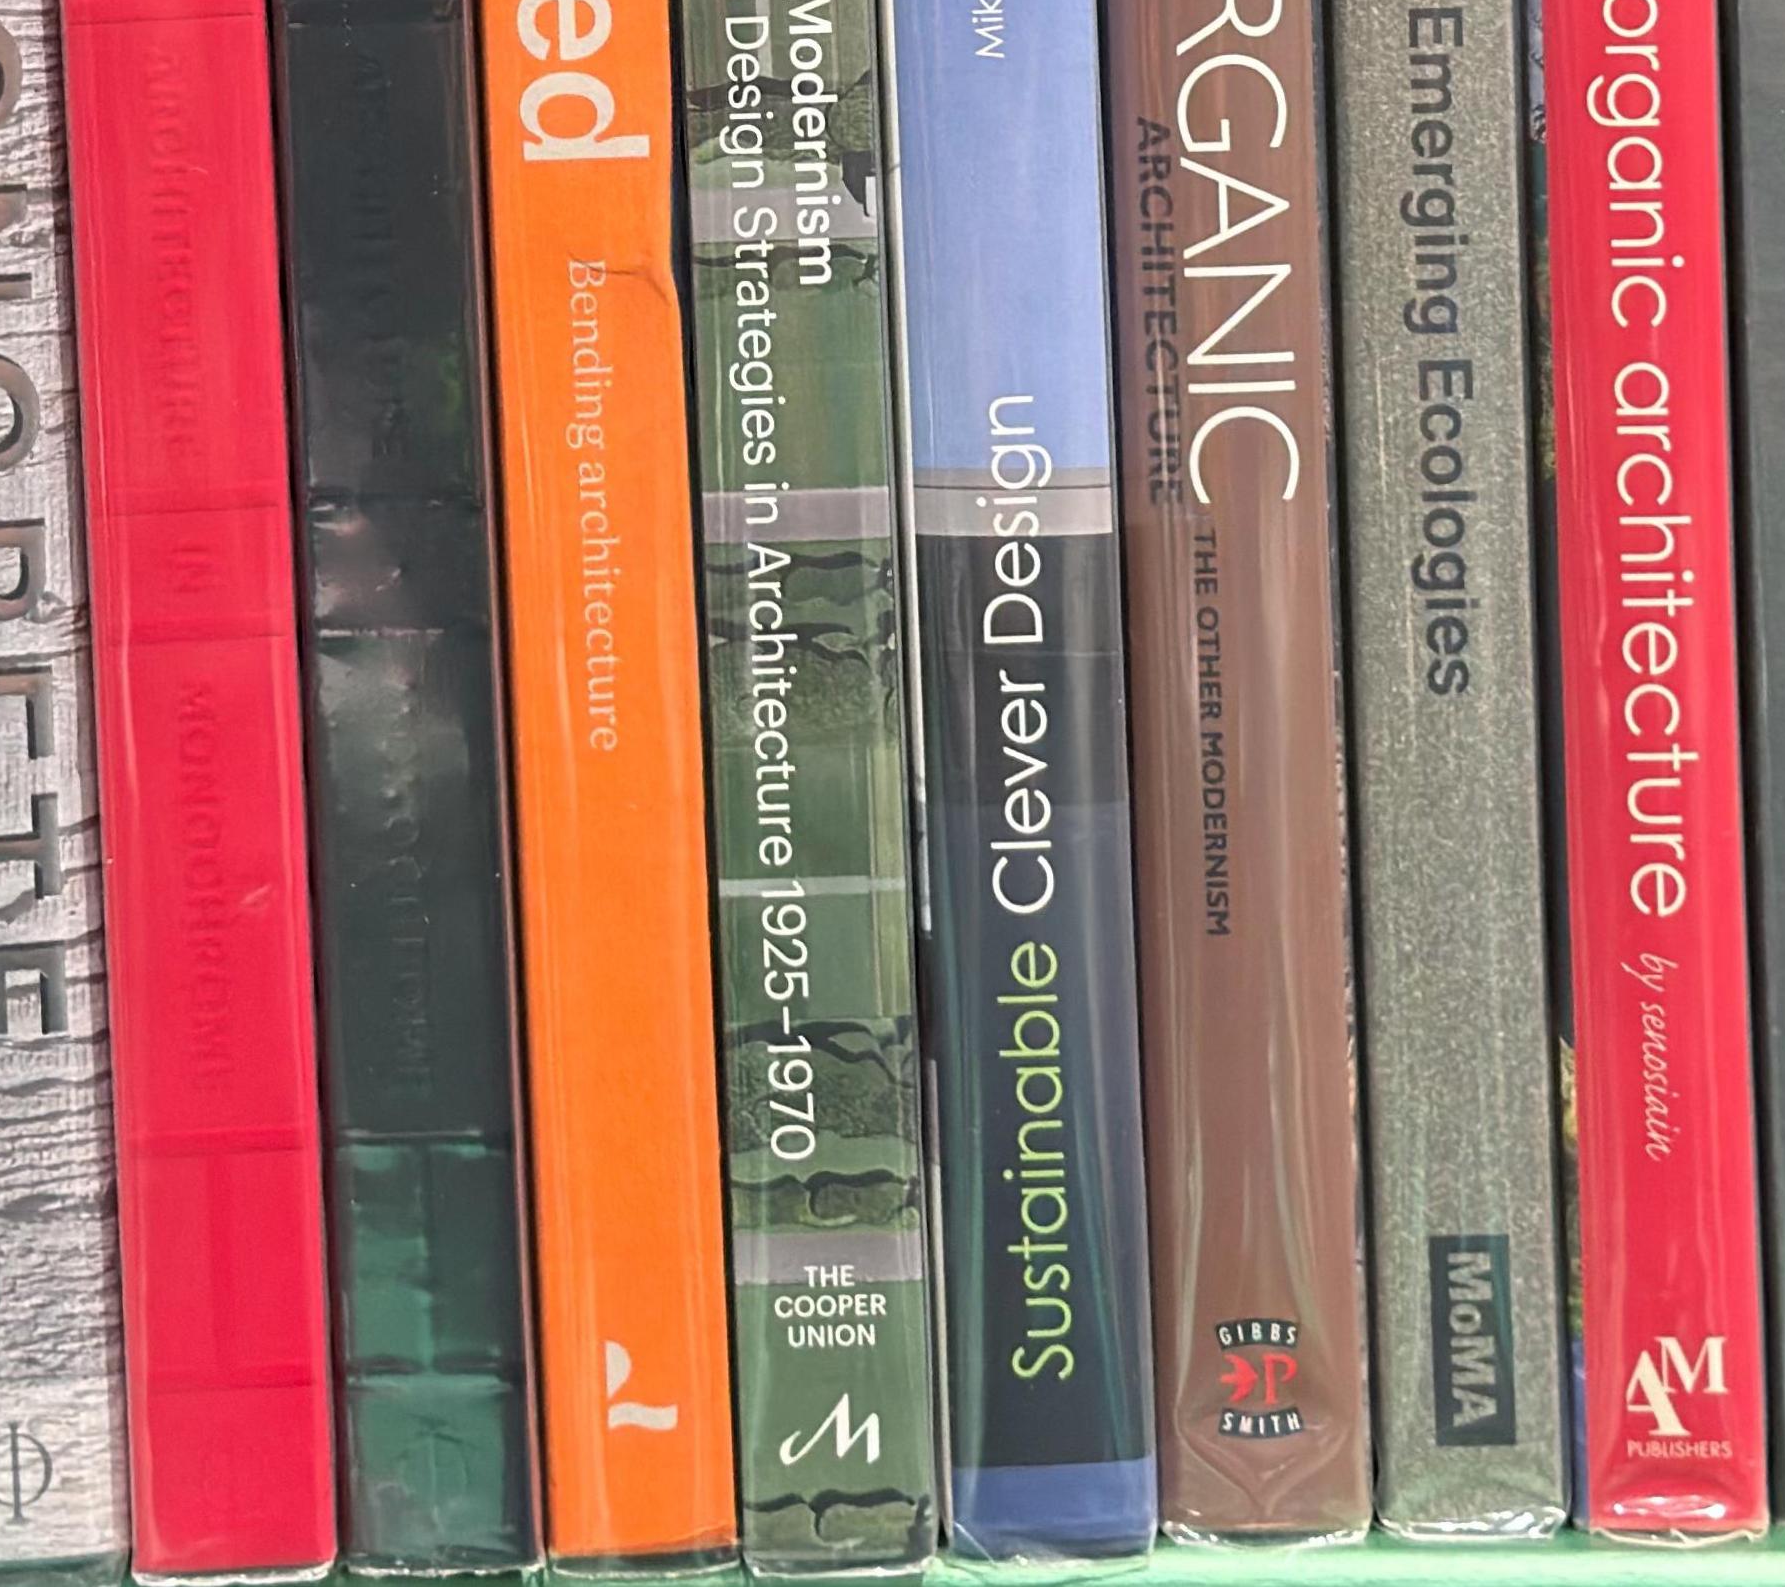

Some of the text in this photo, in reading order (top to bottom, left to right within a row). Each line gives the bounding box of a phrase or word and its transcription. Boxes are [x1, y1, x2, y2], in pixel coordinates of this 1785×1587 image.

[718, 14, 776, 190] Design
[728, 204, 788, 467] Strategies
[1135, 115, 1183, 507] ARCHITECTURE
[1399, 6, 1479, 697] Emerging Ecologies
[565, 258, 622, 753] Bending architecture
[742, 479, 791, 526] in
[745, 540, 799, 867] Architecture
[1614, 361, 1700, 917] architecture
[1193, 528, 1230, 938] THE OTHER MODERNISM
[975, 393, 1075, 1380] Sustainable Clever Design
[1621, 951, 1668, 994] by
[1638, 1000, 1685, 1164] senosiain
[773, 1291, 888, 1320] COOPER
[787, 1322, 878, 1349] UNION
[804, 1263, 856, 1288] THE
[1217, 1321, 1299, 1347] GIBBS
[1446, 1251, 1499, 1427] MoMA
[1222, 1409, 1302, 1434] SMITH
[1626, 1440, 1734, 1460] PUBLISHERS
